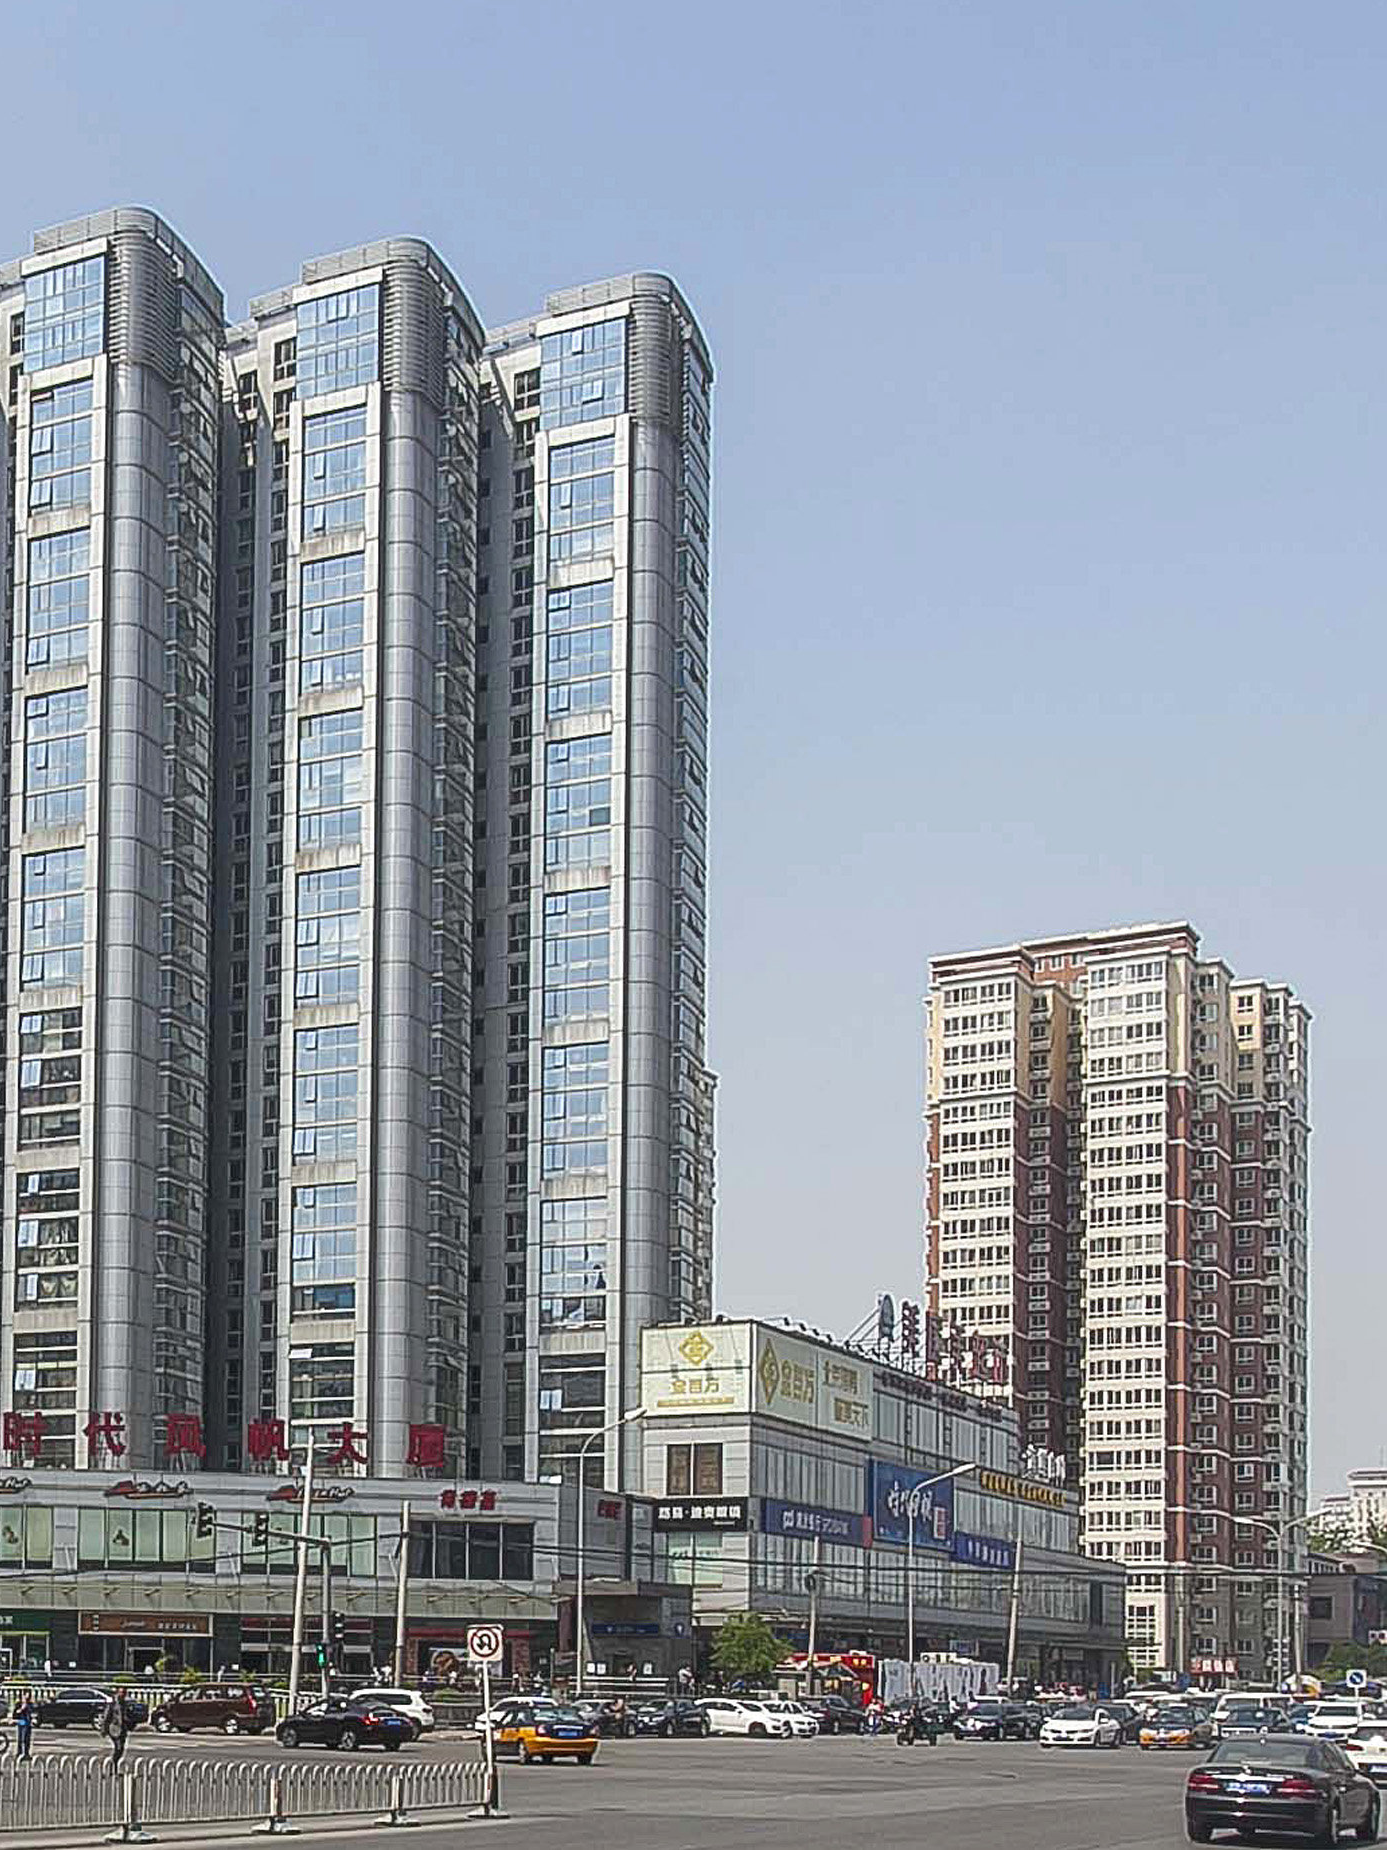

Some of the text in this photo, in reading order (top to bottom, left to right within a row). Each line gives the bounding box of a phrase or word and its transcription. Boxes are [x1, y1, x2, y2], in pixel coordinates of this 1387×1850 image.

[2, 1410, 445, 1468] 时代风帆大厦
[4, 1475, 32, 1490] Hut
